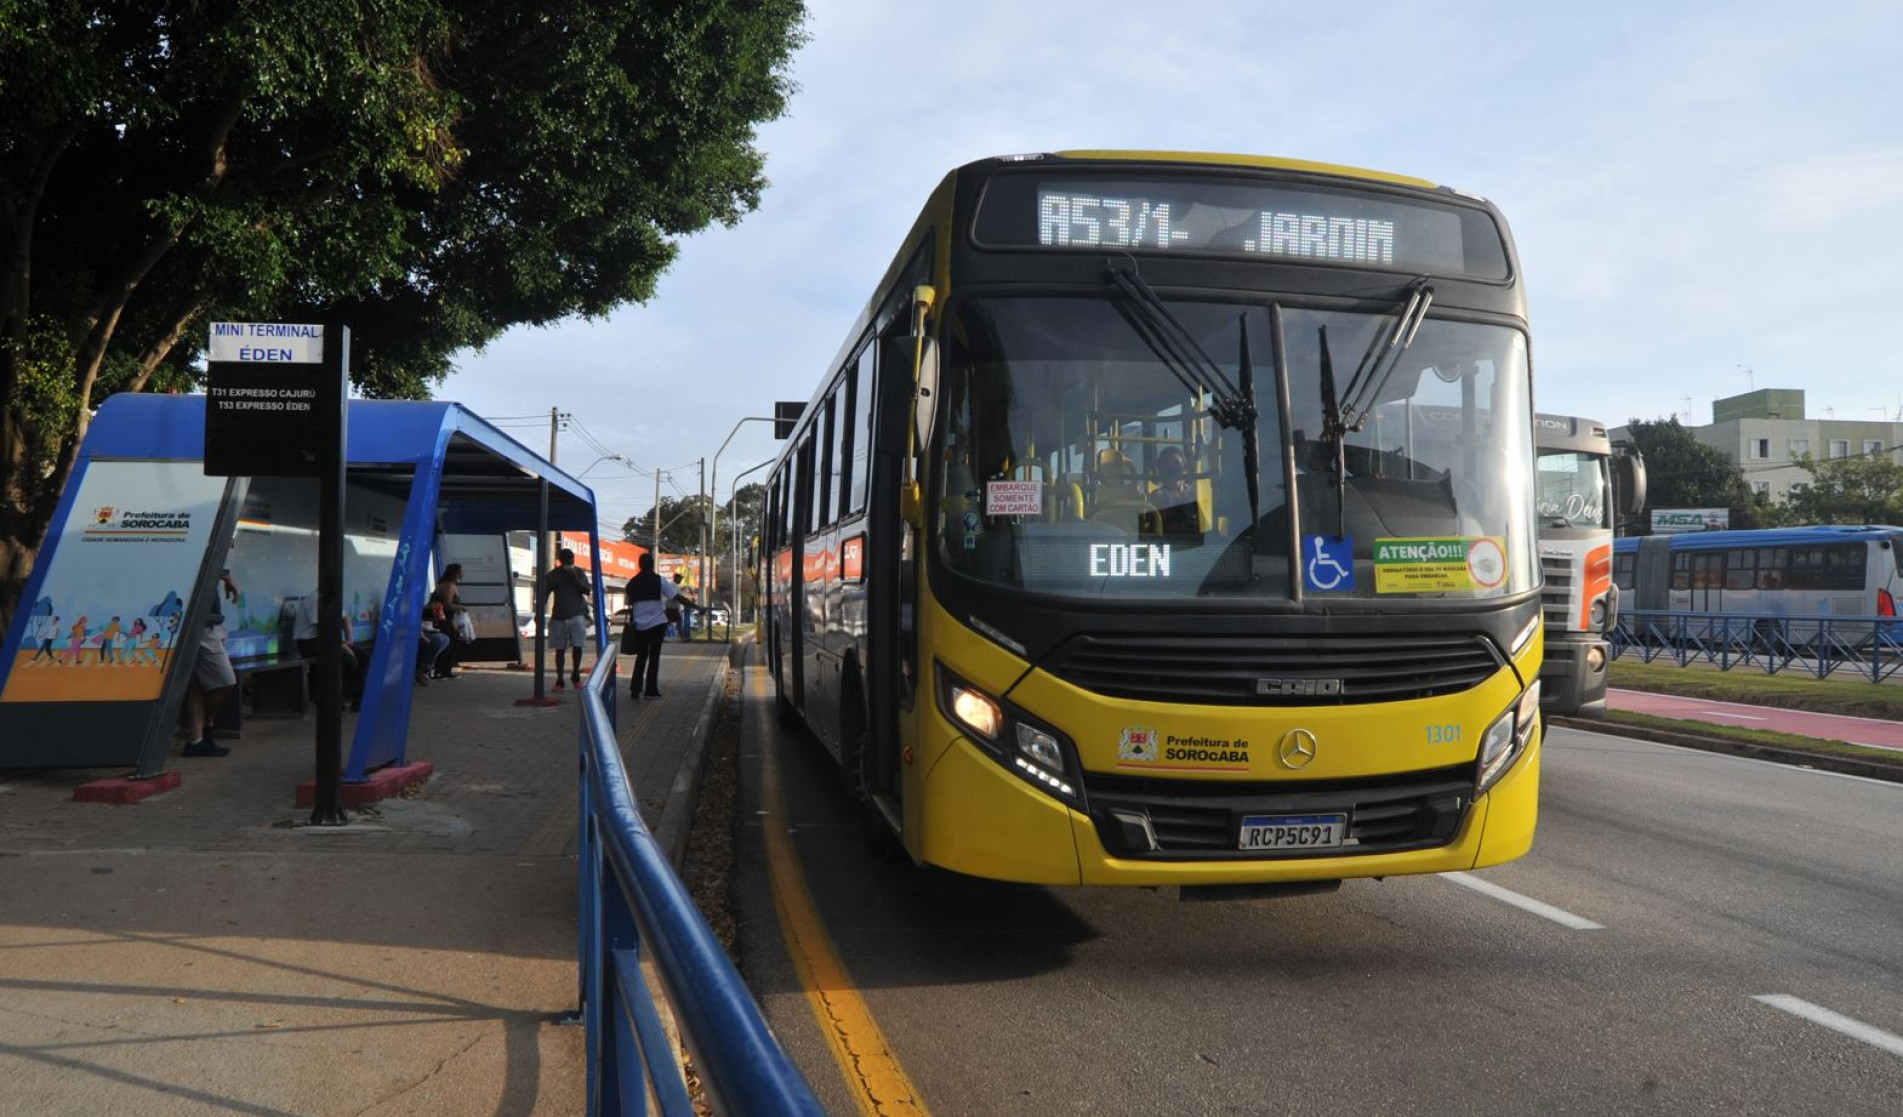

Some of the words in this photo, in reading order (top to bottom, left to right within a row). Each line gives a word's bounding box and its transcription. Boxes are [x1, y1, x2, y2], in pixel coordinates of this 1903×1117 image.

[215, 324, 243, 336] MINI
[249, 325, 319, 338] TERMINAL
[239, 345, 292, 361] ÉDEN
[212, 388, 227, 397] T31
[229, 388, 277, 398] EXPRESSO
[219, 401, 234, 410] T53
[236, 401, 284, 410] EXPRESSO
[286, 400, 311, 411] ÉDEN
[990, 483, 1038, 492] EMBARQUE
[993, 494, 1035, 503] SOMENTE
[989, 504, 1007, 513] COM
[1008, 502, 1038, 513] CARTÃO
[124, 511, 175, 519] Prefeitura
[1657, 514, 1703, 525] MSA
[120, 519, 190, 528] SOROCABA
[1379, 542, 1463, 562] ATENÇÃO!!!
[1090, 544, 1170, 576] EDEN
[1426, 724, 1462, 743] 1301
[1167, 735, 1230, 748] Prefeitura
[1233, 739, 1249, 748] de
[1250, 826, 1332, 847] RCP5C91
